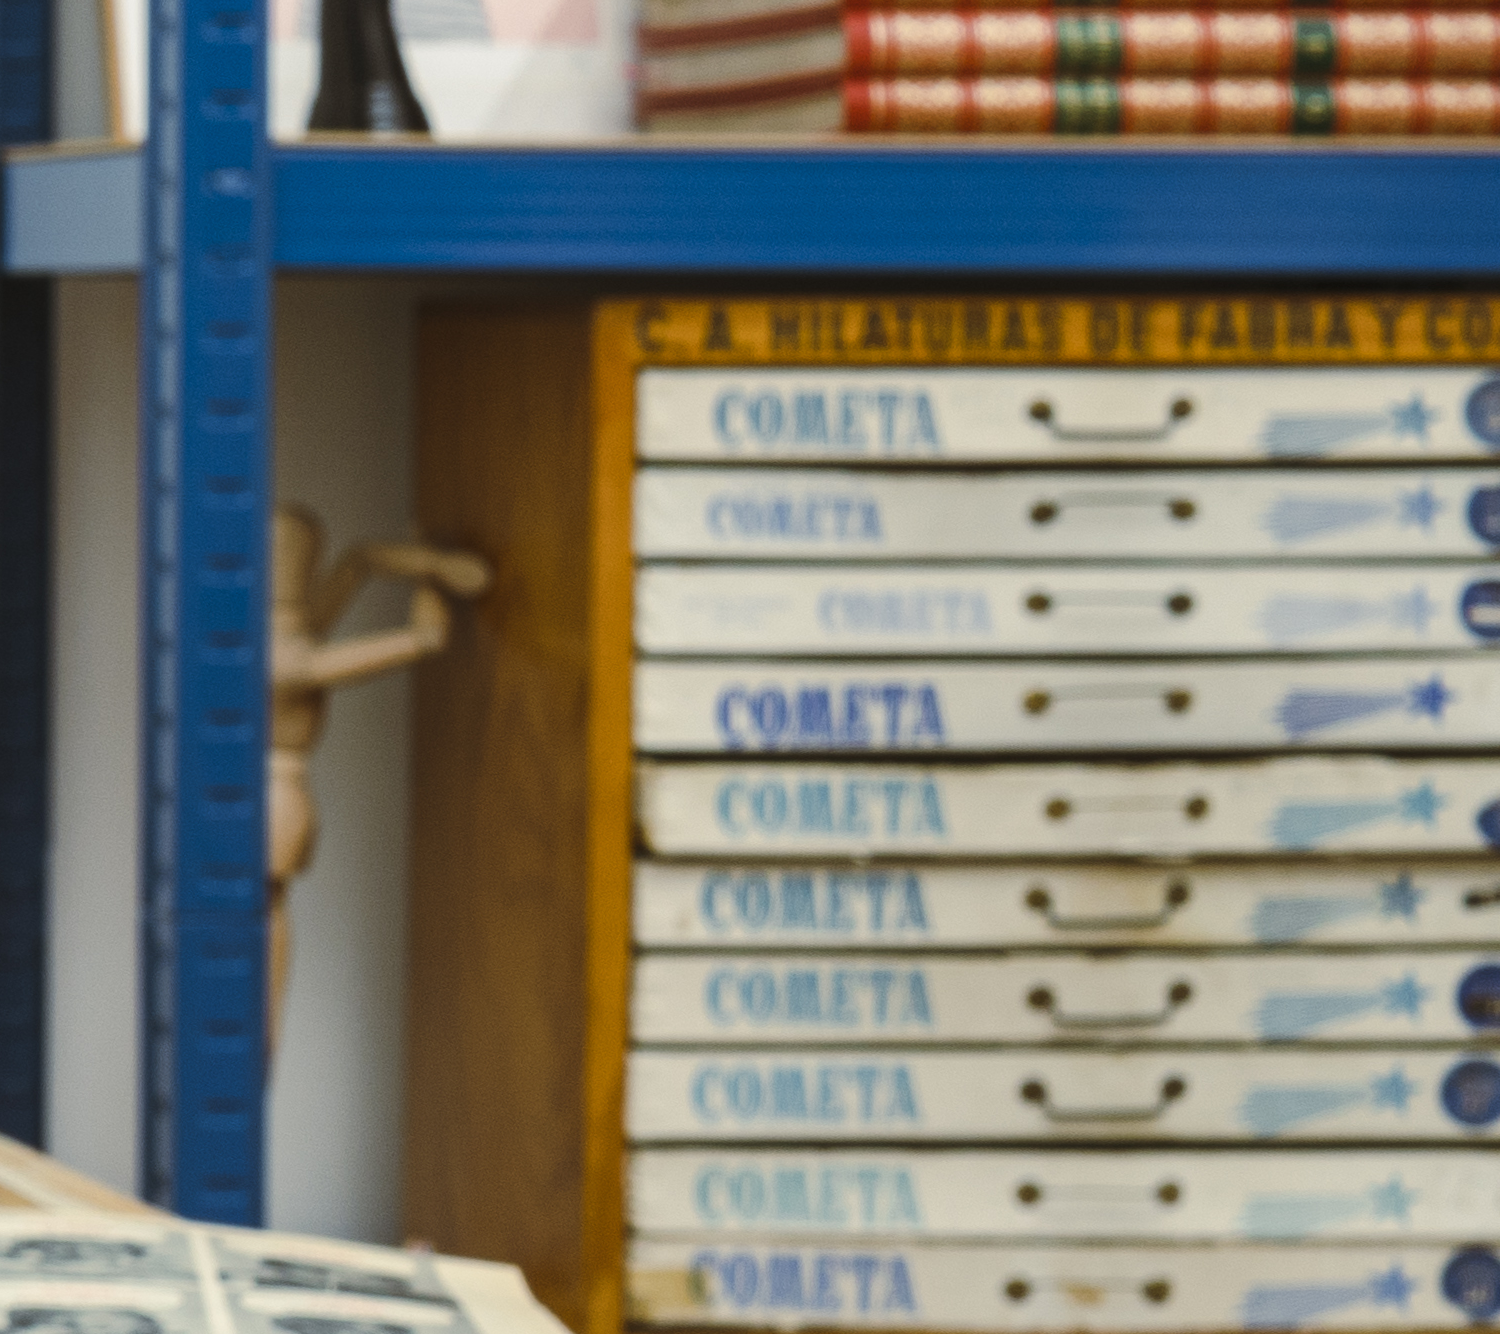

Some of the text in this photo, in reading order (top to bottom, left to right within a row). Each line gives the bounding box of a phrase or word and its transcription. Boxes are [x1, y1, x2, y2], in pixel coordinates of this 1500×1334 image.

[712, 383, 942, 453] COMETA
[704, 491, 884, 544] COMETA
[713, 680, 947, 752] COMETA
[713, 774, 948, 839] COMETA
[698, 869, 930, 935] COMETA
[706, 966, 935, 1029] COMETA
[689, 1061, 919, 1123] COMETA
[692, 1163, 922, 1229] COMETA
[686, 1249, 919, 1316] COMETA
